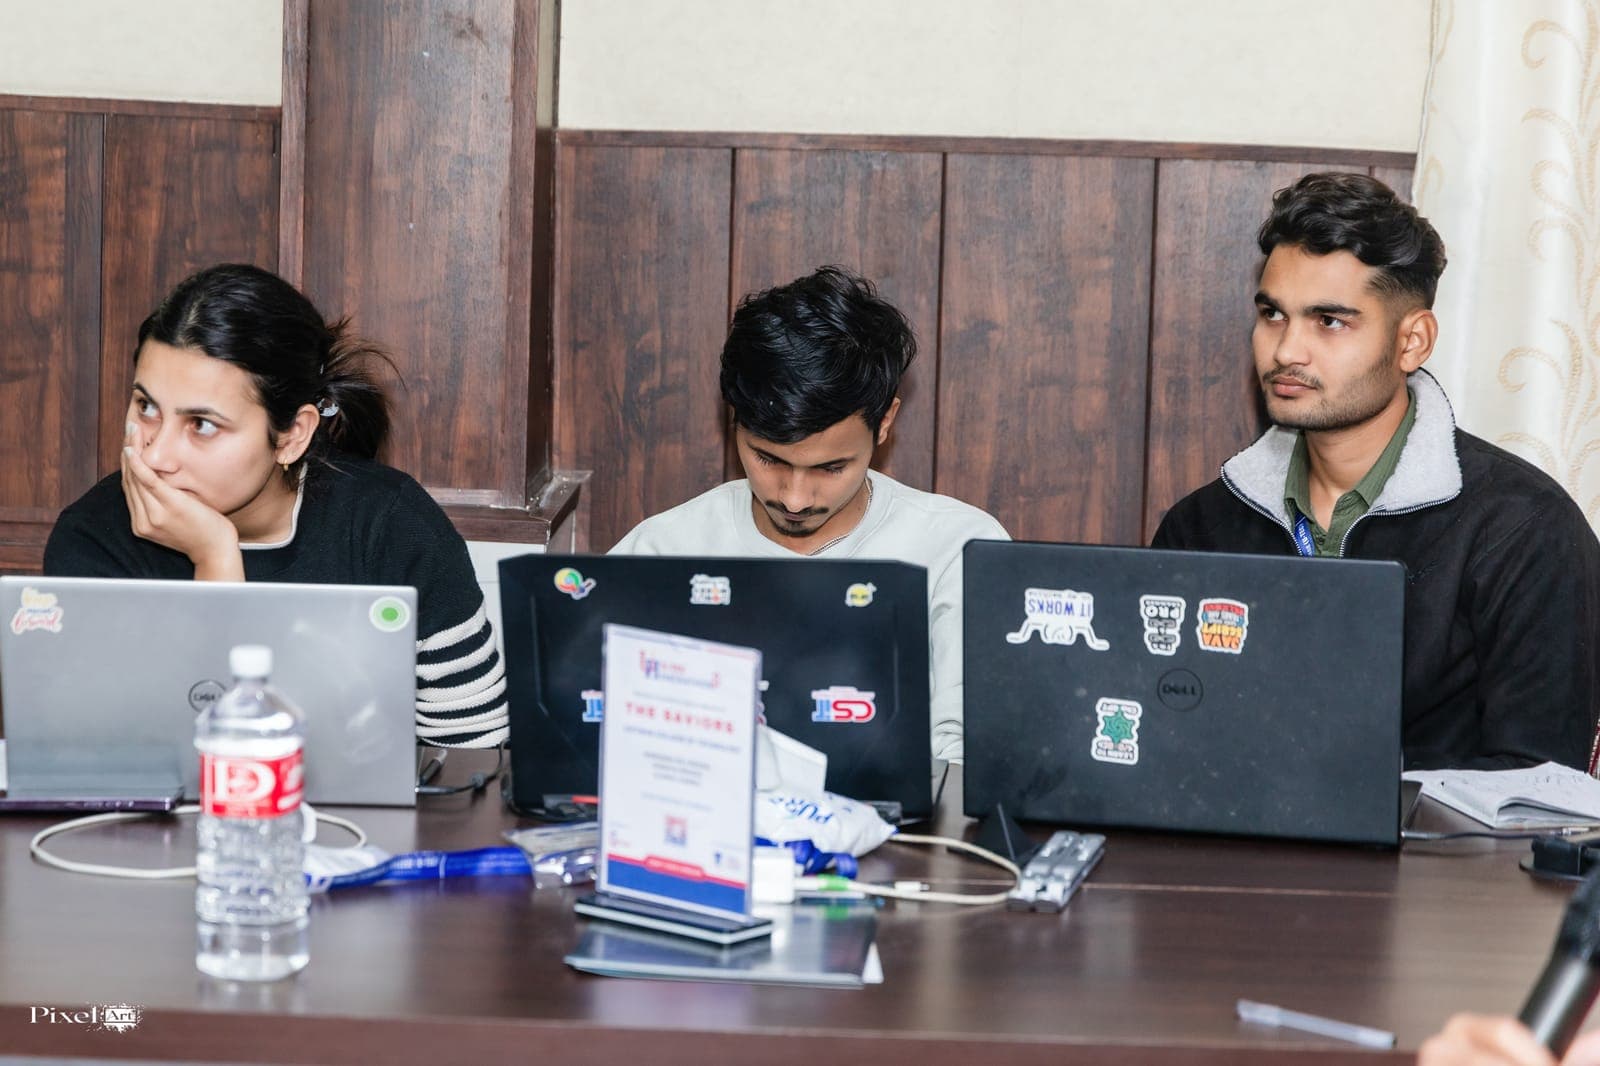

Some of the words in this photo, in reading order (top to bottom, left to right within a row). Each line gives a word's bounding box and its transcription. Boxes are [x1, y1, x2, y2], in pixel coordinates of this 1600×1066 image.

[1028, 599, 1075, 616] WORKS
[1080, 603, 1091, 617] IT
[1144, 605, 1180, 619] PRO
[1201, 623, 1243, 637] SCRIPT
[1202, 633, 1241, 650] JAVA
[1162, 684, 1196, 695] DELL
[663, 709, 734, 735] SAVIORS
